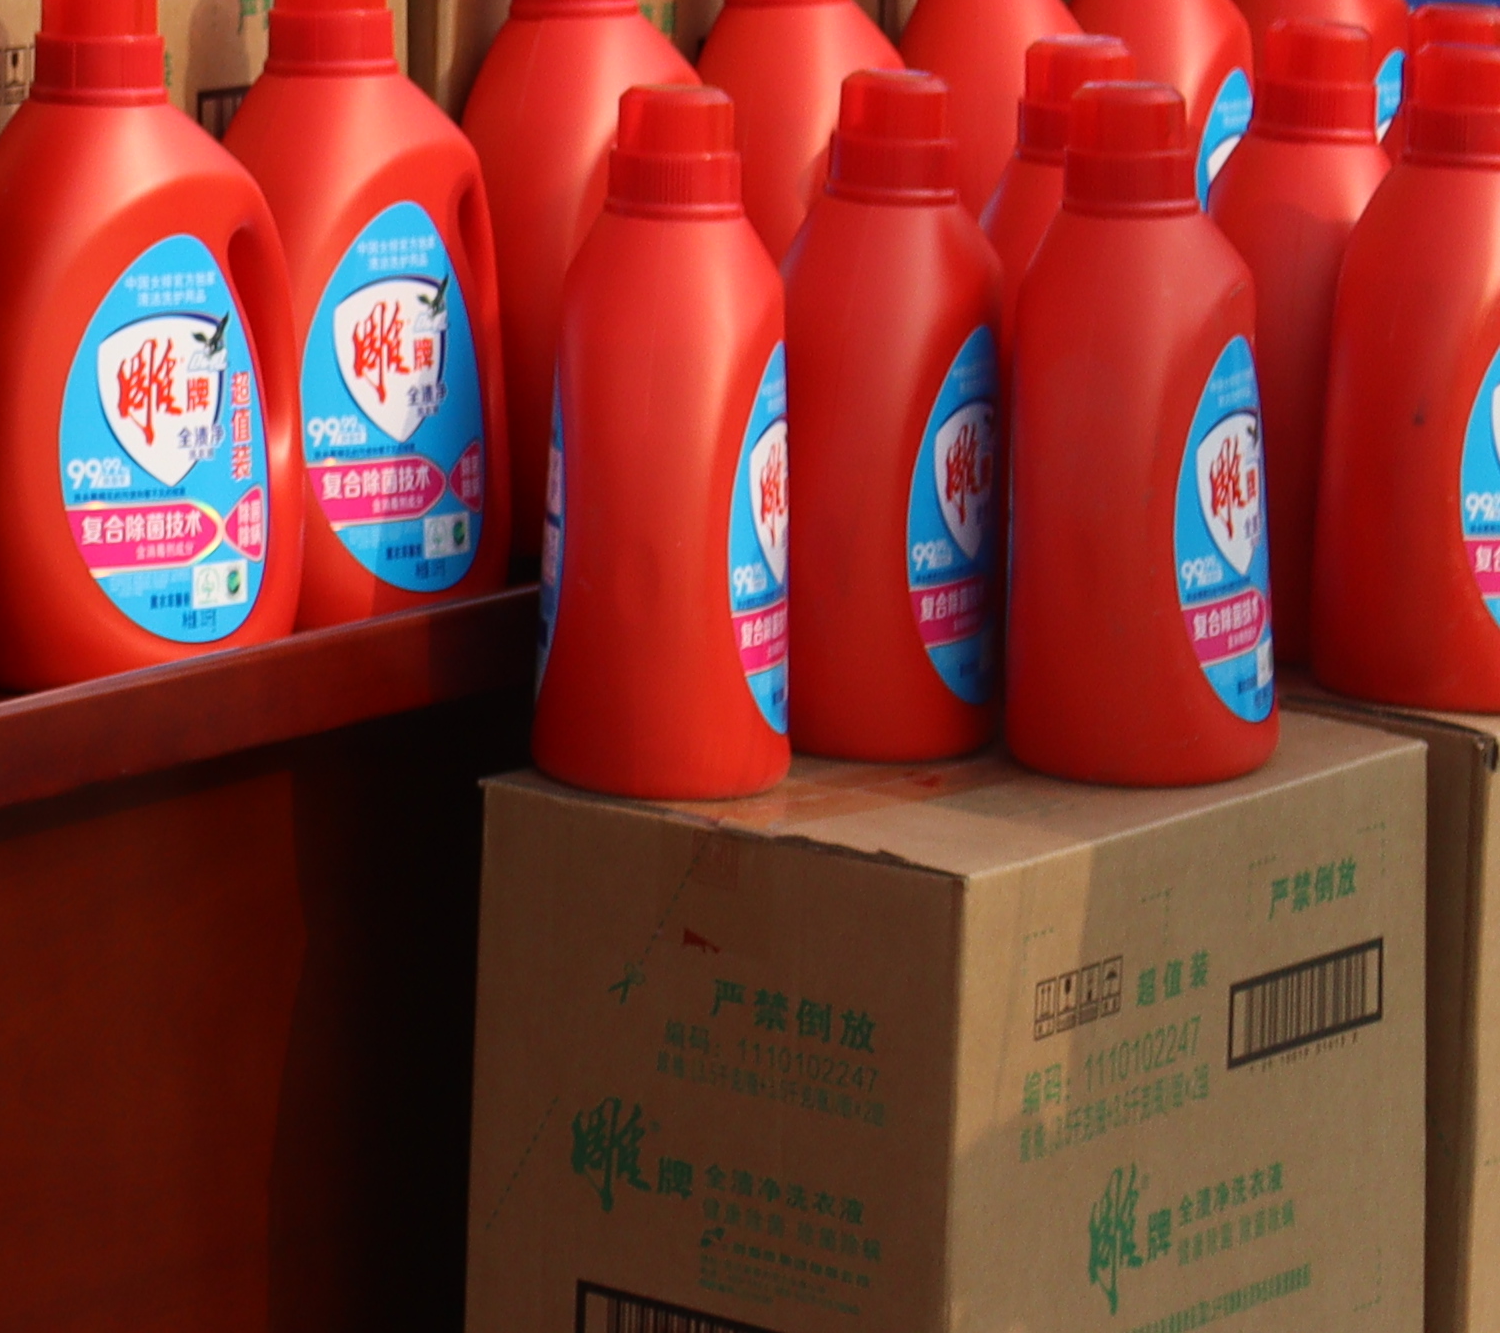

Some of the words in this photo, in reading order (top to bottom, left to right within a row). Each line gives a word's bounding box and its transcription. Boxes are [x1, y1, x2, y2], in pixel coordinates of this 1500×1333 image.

[230, 371, 252, 481] 超值装
[322, 470, 431, 499] 复合除菌技术
[81, 511, 202, 545] 复合除菌技术
[710, 979, 877, 1054] 严禁倒放
